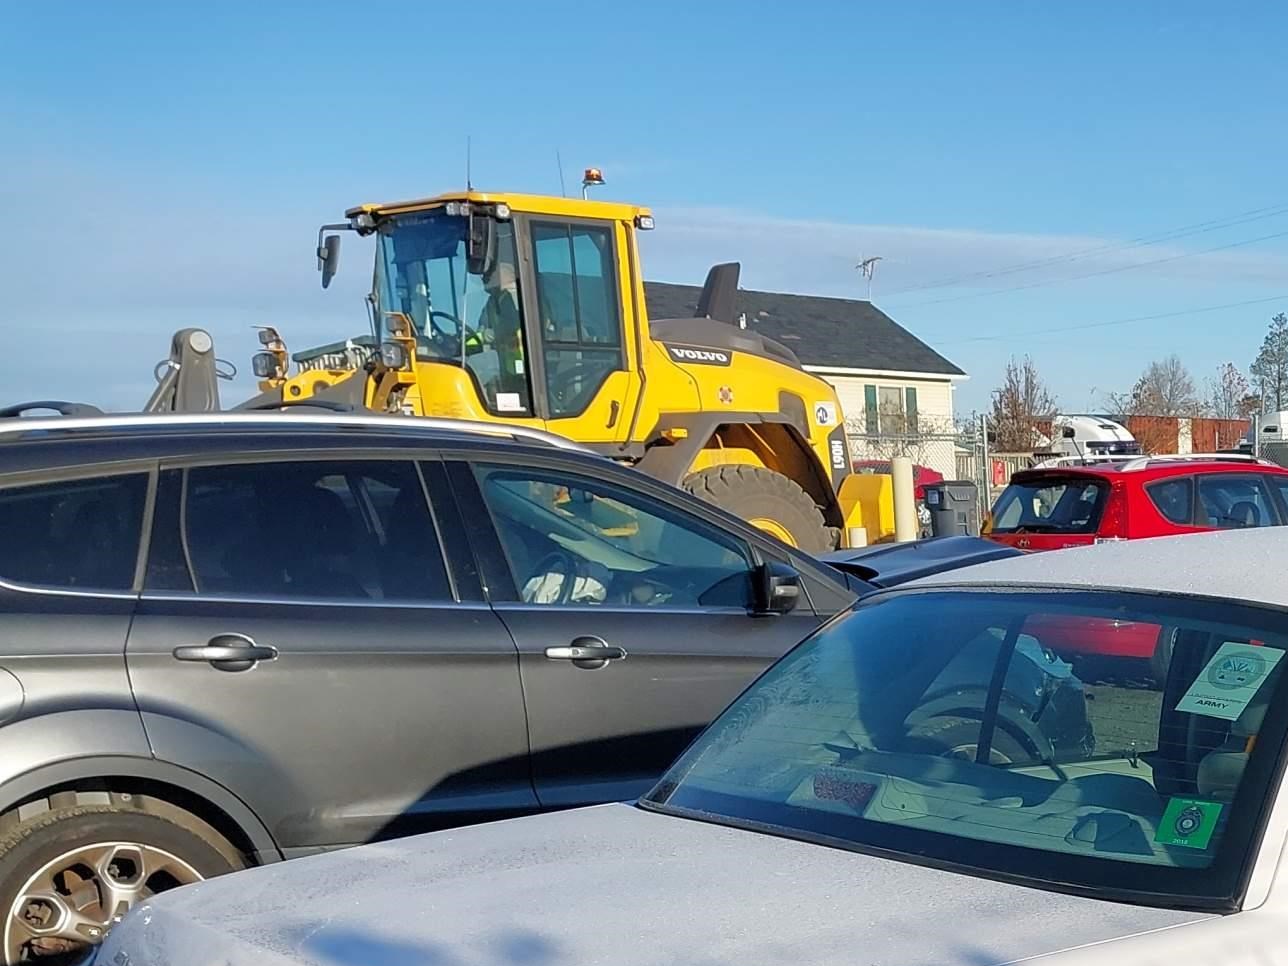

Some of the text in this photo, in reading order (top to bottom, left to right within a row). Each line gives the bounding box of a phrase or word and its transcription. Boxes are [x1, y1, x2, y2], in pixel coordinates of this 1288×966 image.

[670, 347, 728, 362] VOLVO
[831, 440, 845, 469] L90H
[1195, 699, 1229, 710] ARMY
